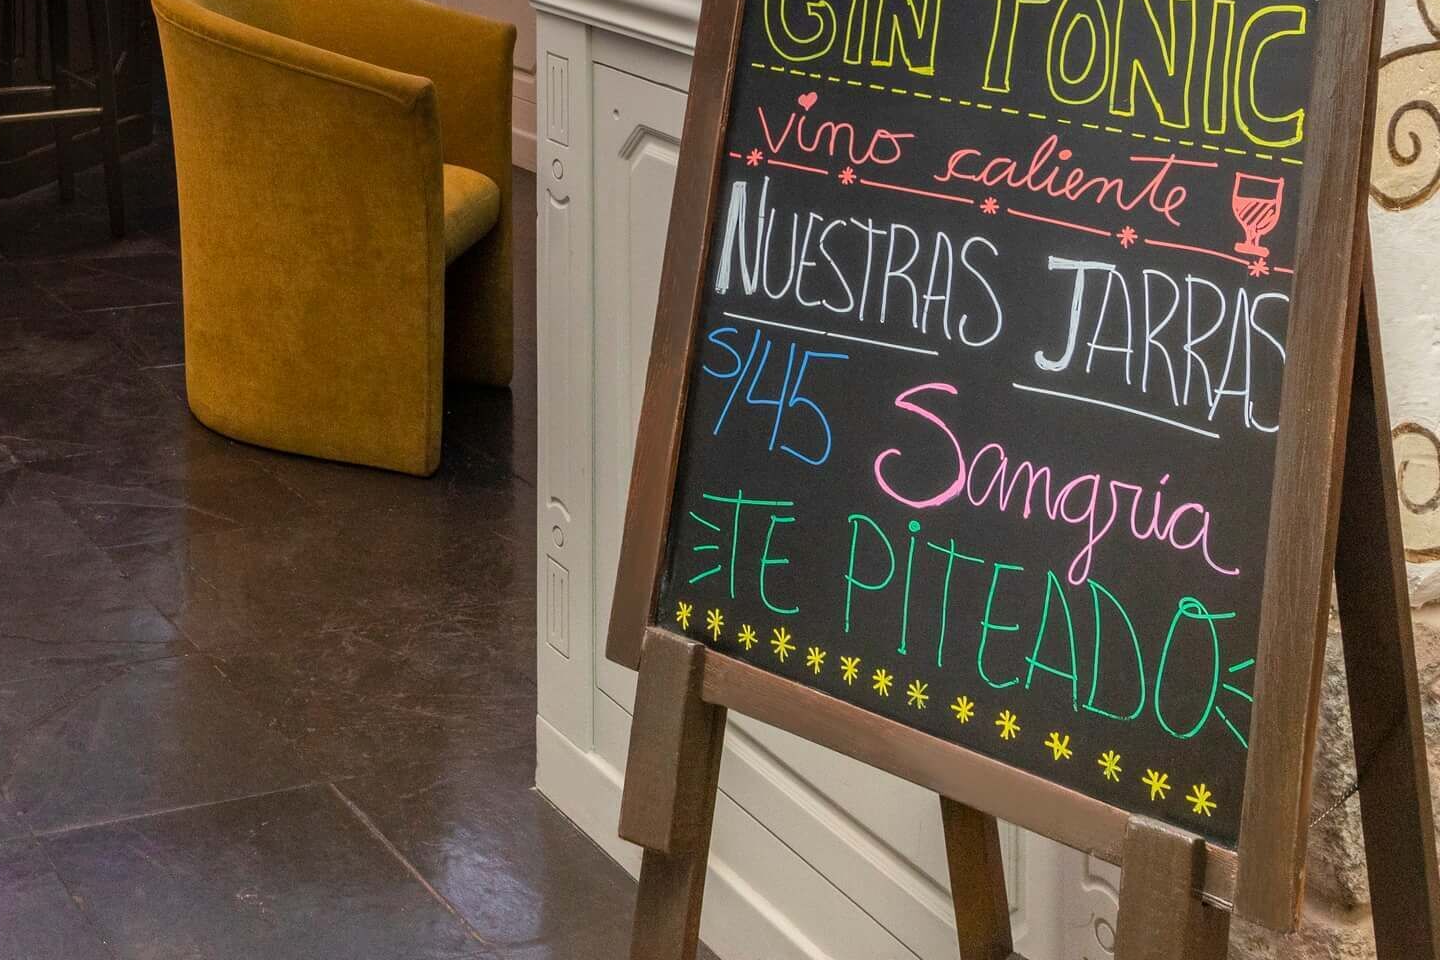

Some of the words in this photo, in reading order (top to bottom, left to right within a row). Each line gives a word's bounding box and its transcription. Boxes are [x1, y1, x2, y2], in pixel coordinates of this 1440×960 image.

[757, 91, 915, 166] vino
[934, 133, 1220, 228] caliente
[714, 175, 1005, 348] NUESTRAS
[1032, 253, 1291, 434] JARRAS
[701, 488, 800, 616] TE
